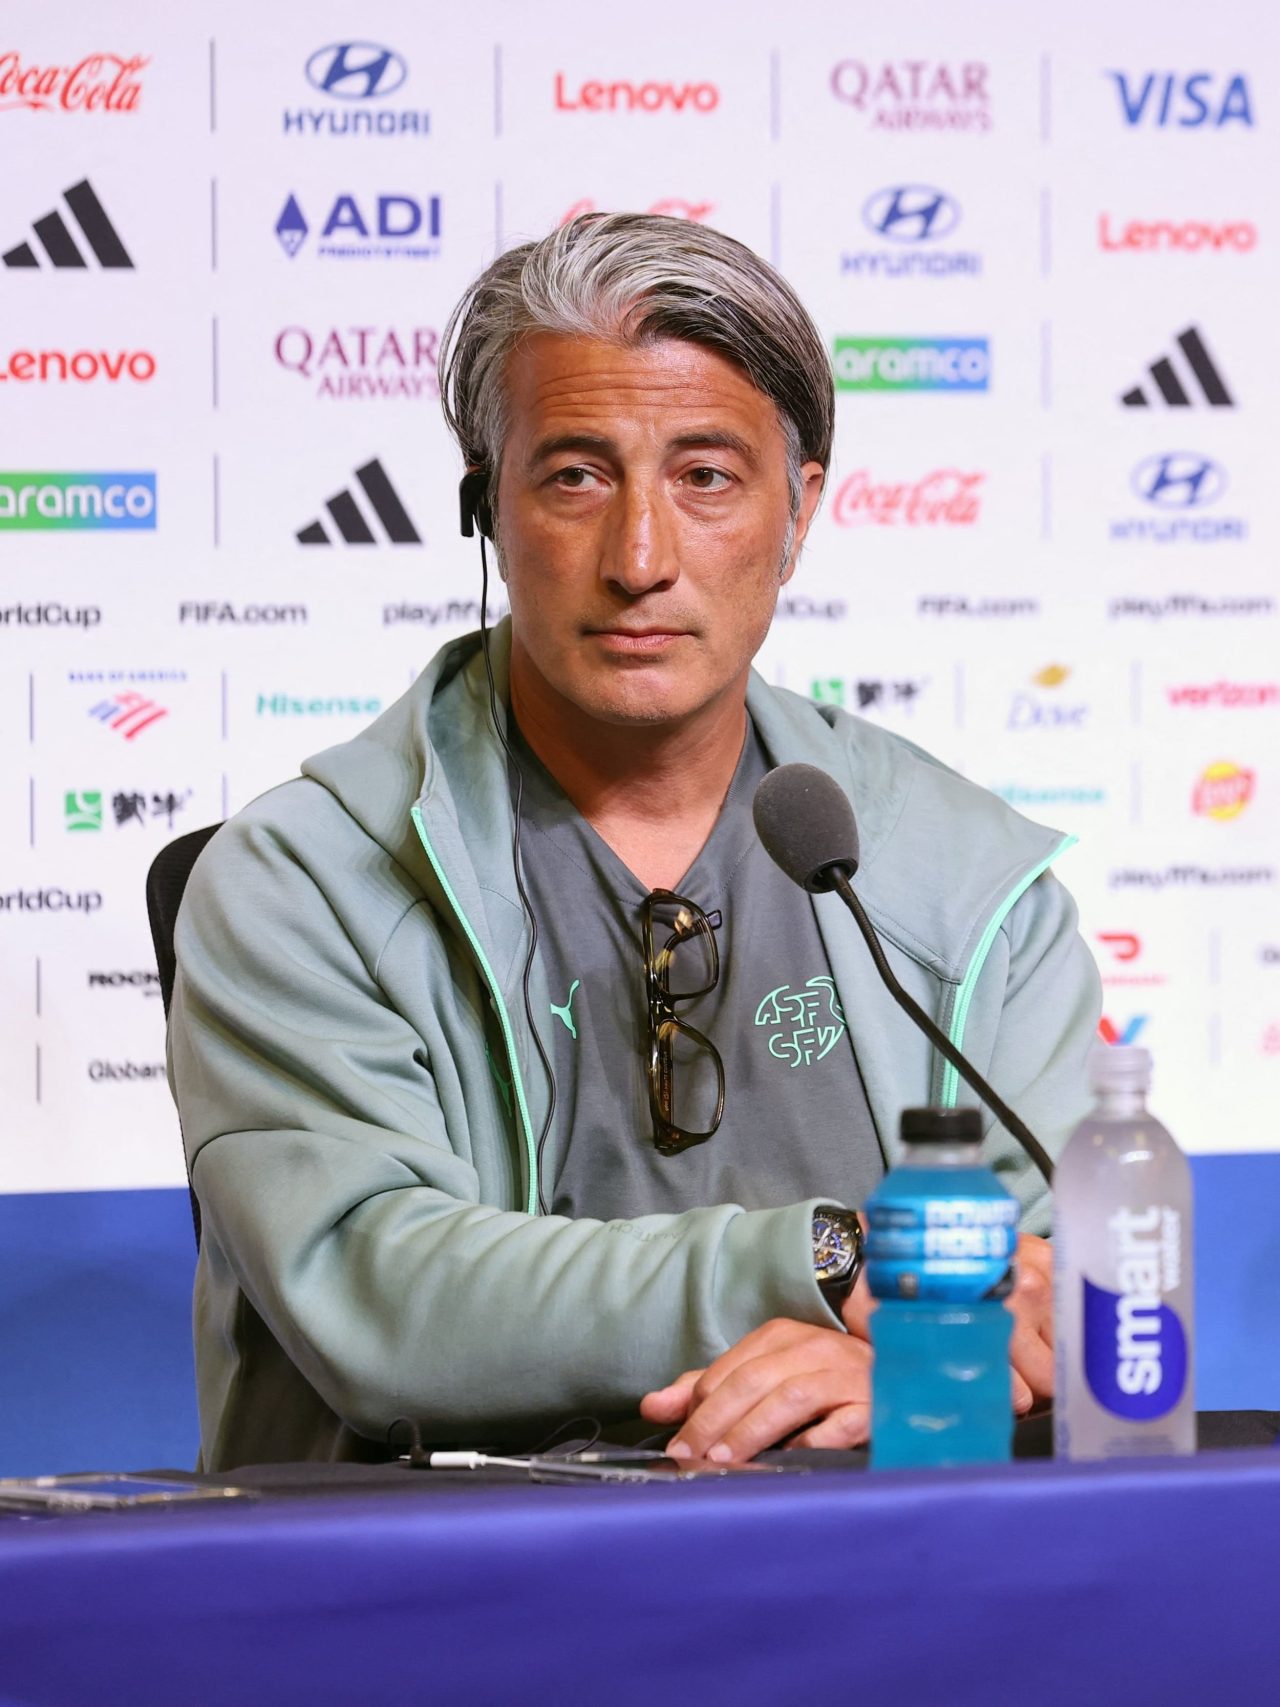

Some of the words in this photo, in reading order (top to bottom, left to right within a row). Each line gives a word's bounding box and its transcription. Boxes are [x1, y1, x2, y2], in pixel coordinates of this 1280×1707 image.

[554, 73, 720, 113] Lenovo
[829, 60, 989, 105] QATAR
[1112, 72, 1254, 128] VISA
[283, 110, 430, 136] HYUNDAI
[874, 106, 991, 131] AIRWAYS
[322, 195, 441, 239] ADI
[1098, 214, 1258, 253] Lenovo
[840, 251, 982, 278] HYUNDAI
[274, 329, 436, 377] QATAR
[836, 345, 986, 383] aramco
[179, 602, 307, 624] FIFA.com
[256, 694, 382, 716] Hisense
[1107, 1205, 1162, 1395] smart
